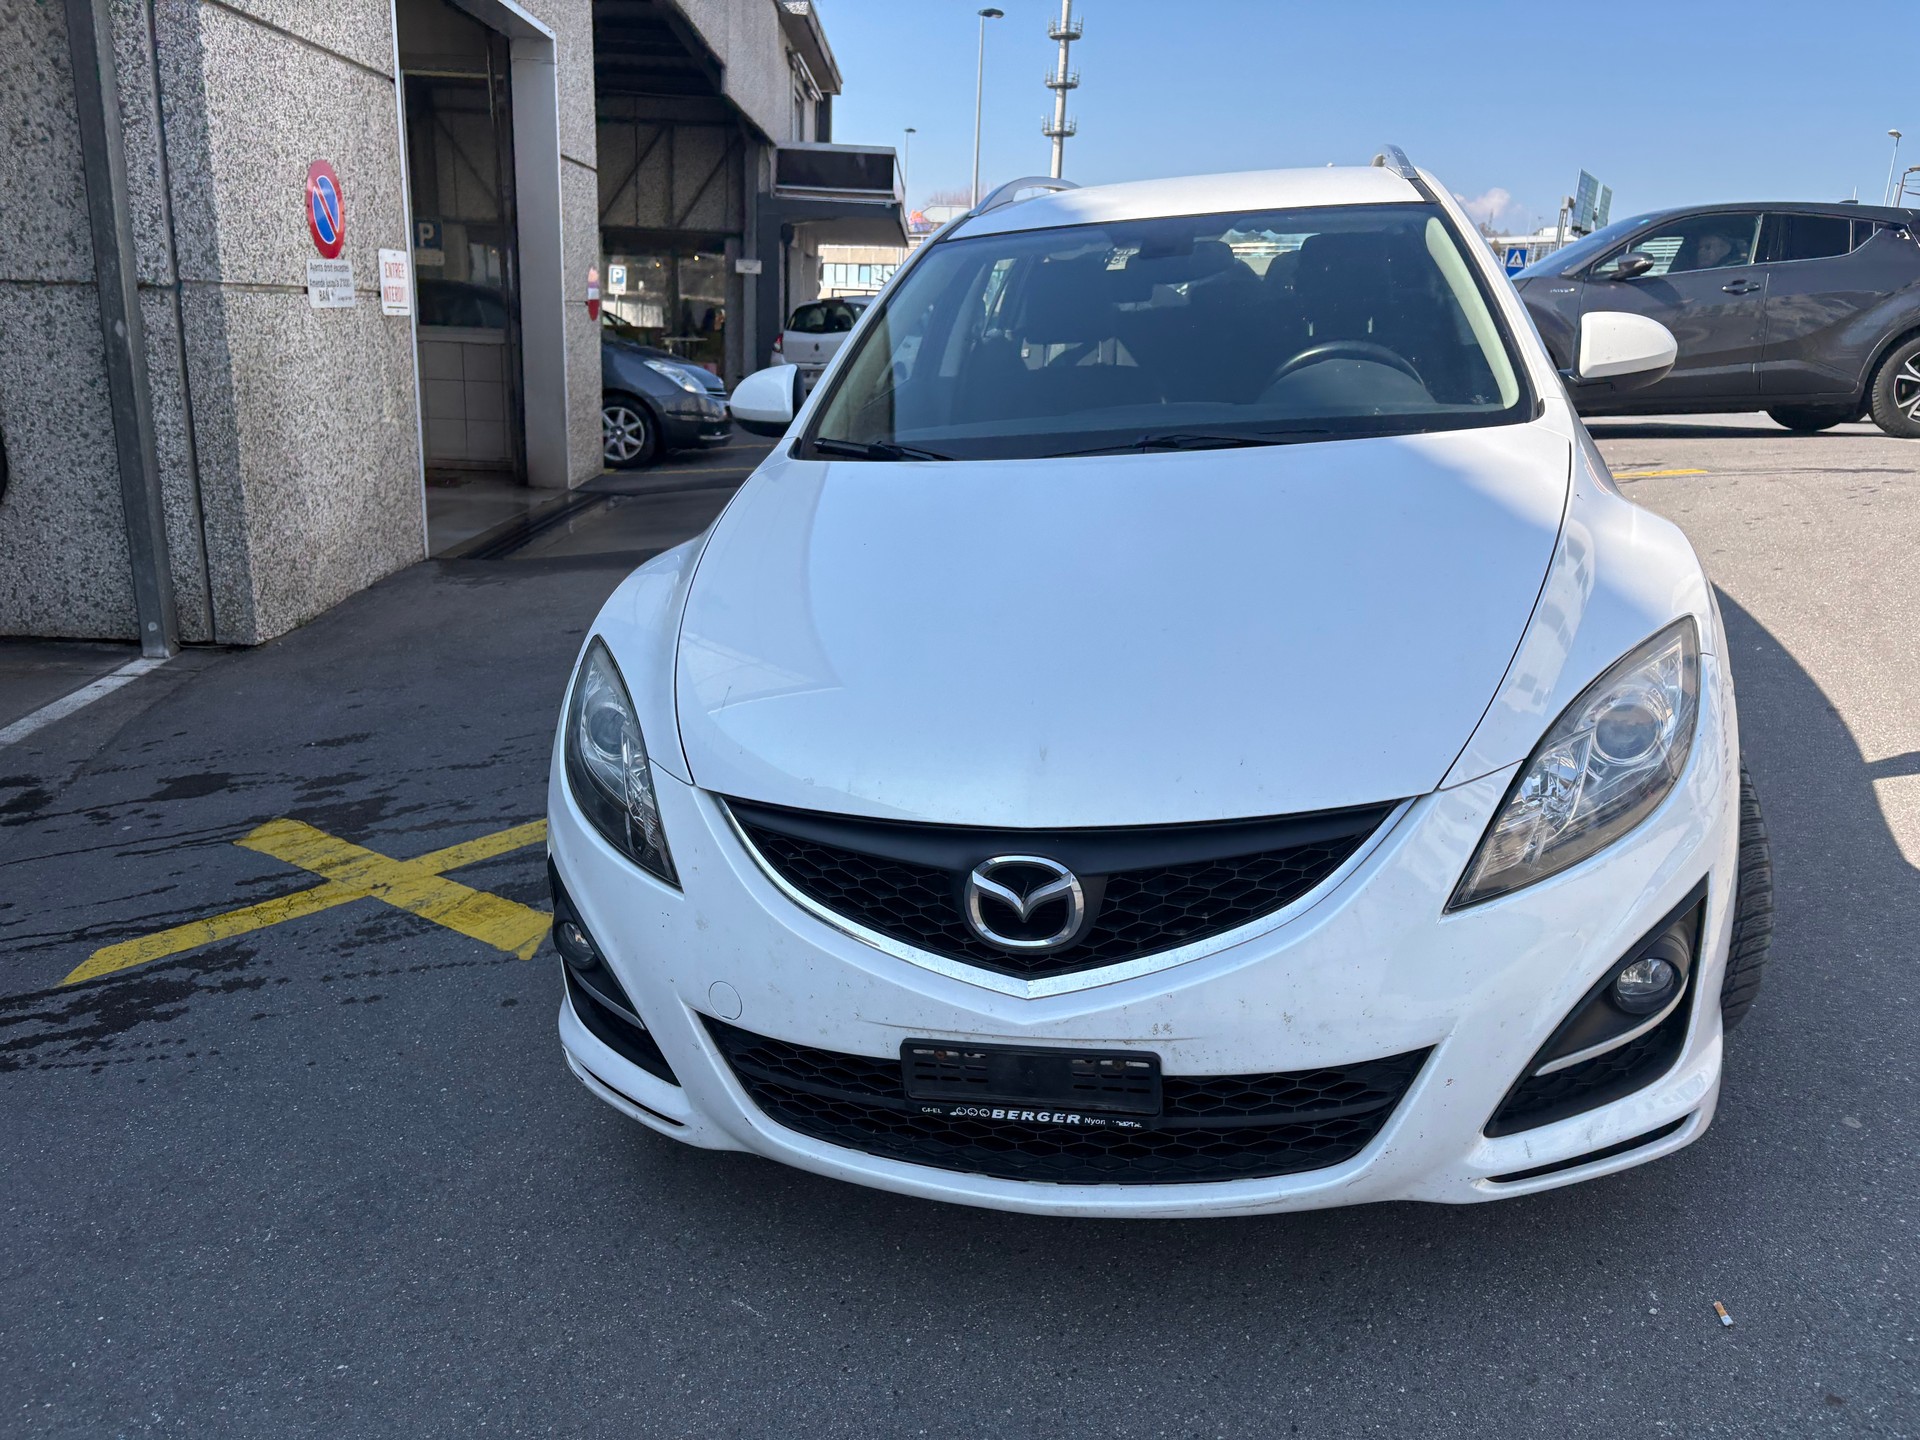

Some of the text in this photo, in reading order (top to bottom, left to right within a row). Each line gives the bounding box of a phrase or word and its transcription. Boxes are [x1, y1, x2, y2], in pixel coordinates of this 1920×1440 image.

[612, 268, 623, 283] P
[992, 1109, 1081, 1124] BERGER
[1085, 1117, 1106, 1126] Nyon
